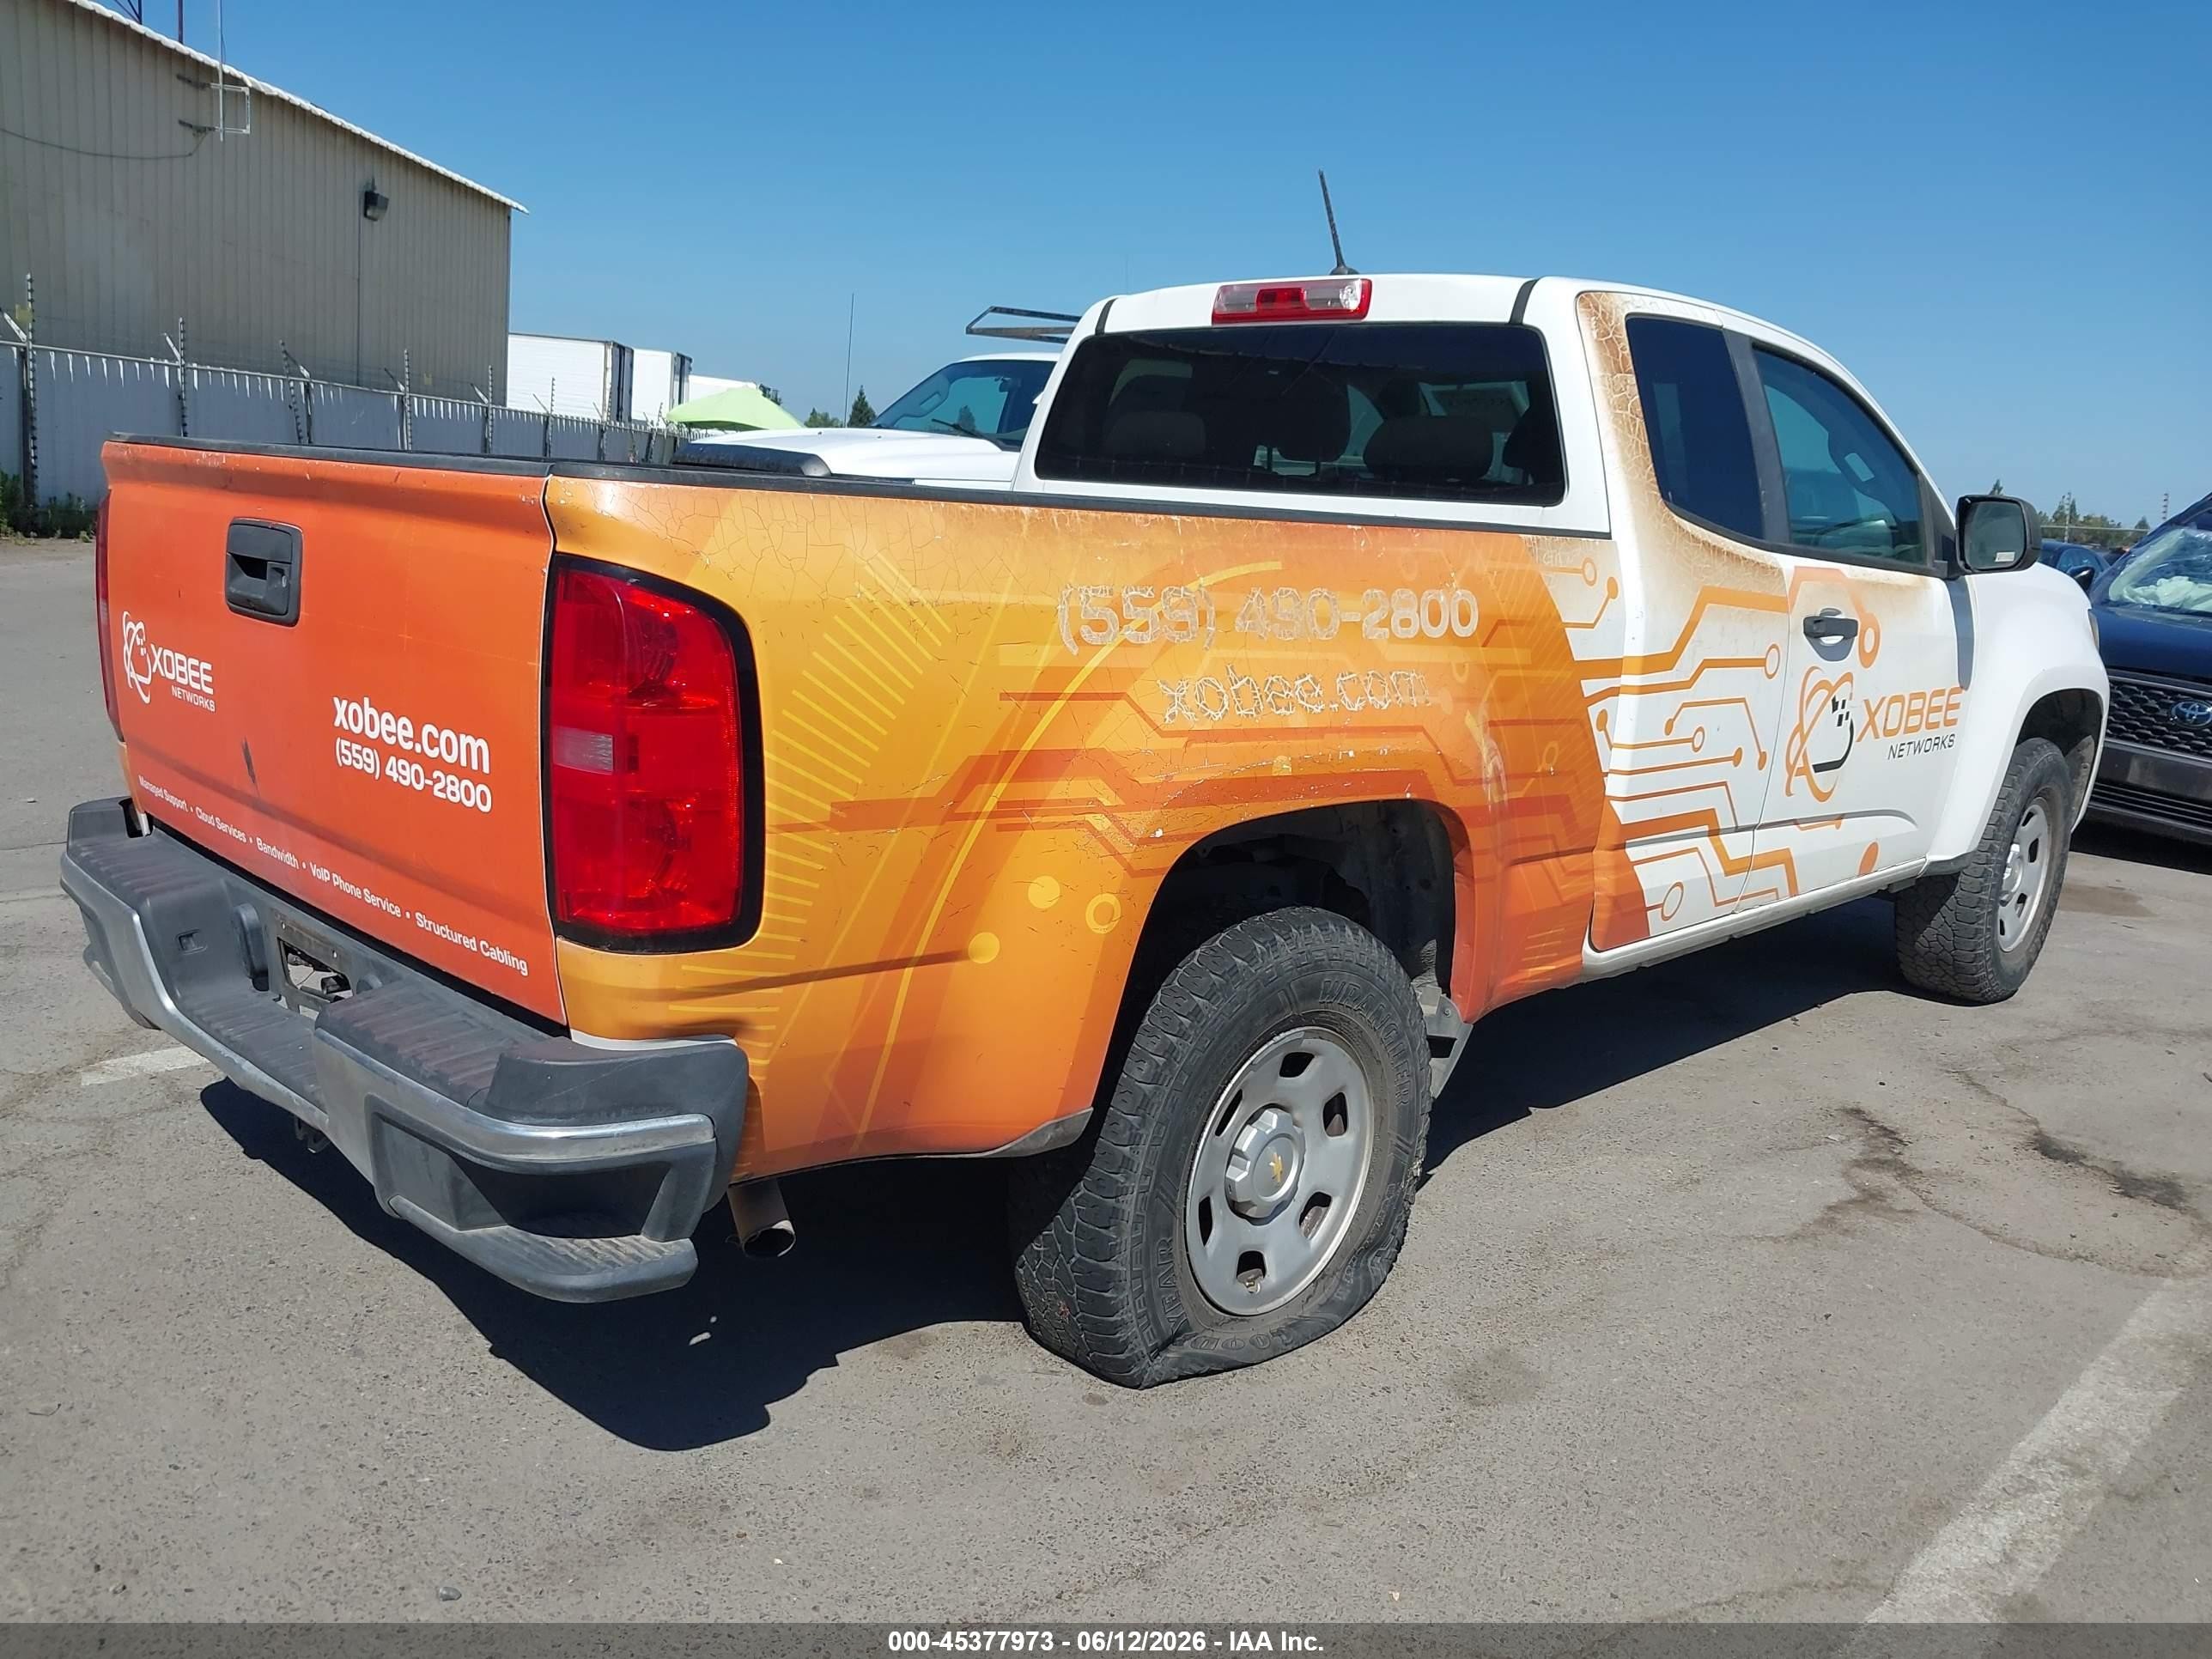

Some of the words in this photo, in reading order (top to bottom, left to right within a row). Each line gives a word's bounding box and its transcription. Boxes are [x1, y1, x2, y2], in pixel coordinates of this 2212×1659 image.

[1058, 584, 1215, 655] (559)
[1235, 586, 1479, 640] 490-2800
[150, 643, 214, 696] XOBEE
[171, 684, 216, 712] NETWORKS
[1157, 665, 1432, 723] xobee.com
[333, 696, 489, 774] xobee.com
[1856, 687, 1964, 743] XOBEE
[336, 738, 380, 780] (559)
[386, 756, 492, 812] 490-2800
[1887, 733, 1955, 760] NETWORKS
[164, 790, 188, 812] Support
[195, 806, 215, 826] Cloud
[215, 817, 246, 843] Services
[256, 837, 300, 869] Bandwidth
[310, 861, 331, 883] VoIP
[332, 872, 362, 900] Phone
[363, 888, 402, 917] Service
[416, 911, 477, 951] Structured
[479, 939, 529, 976] Cabling
